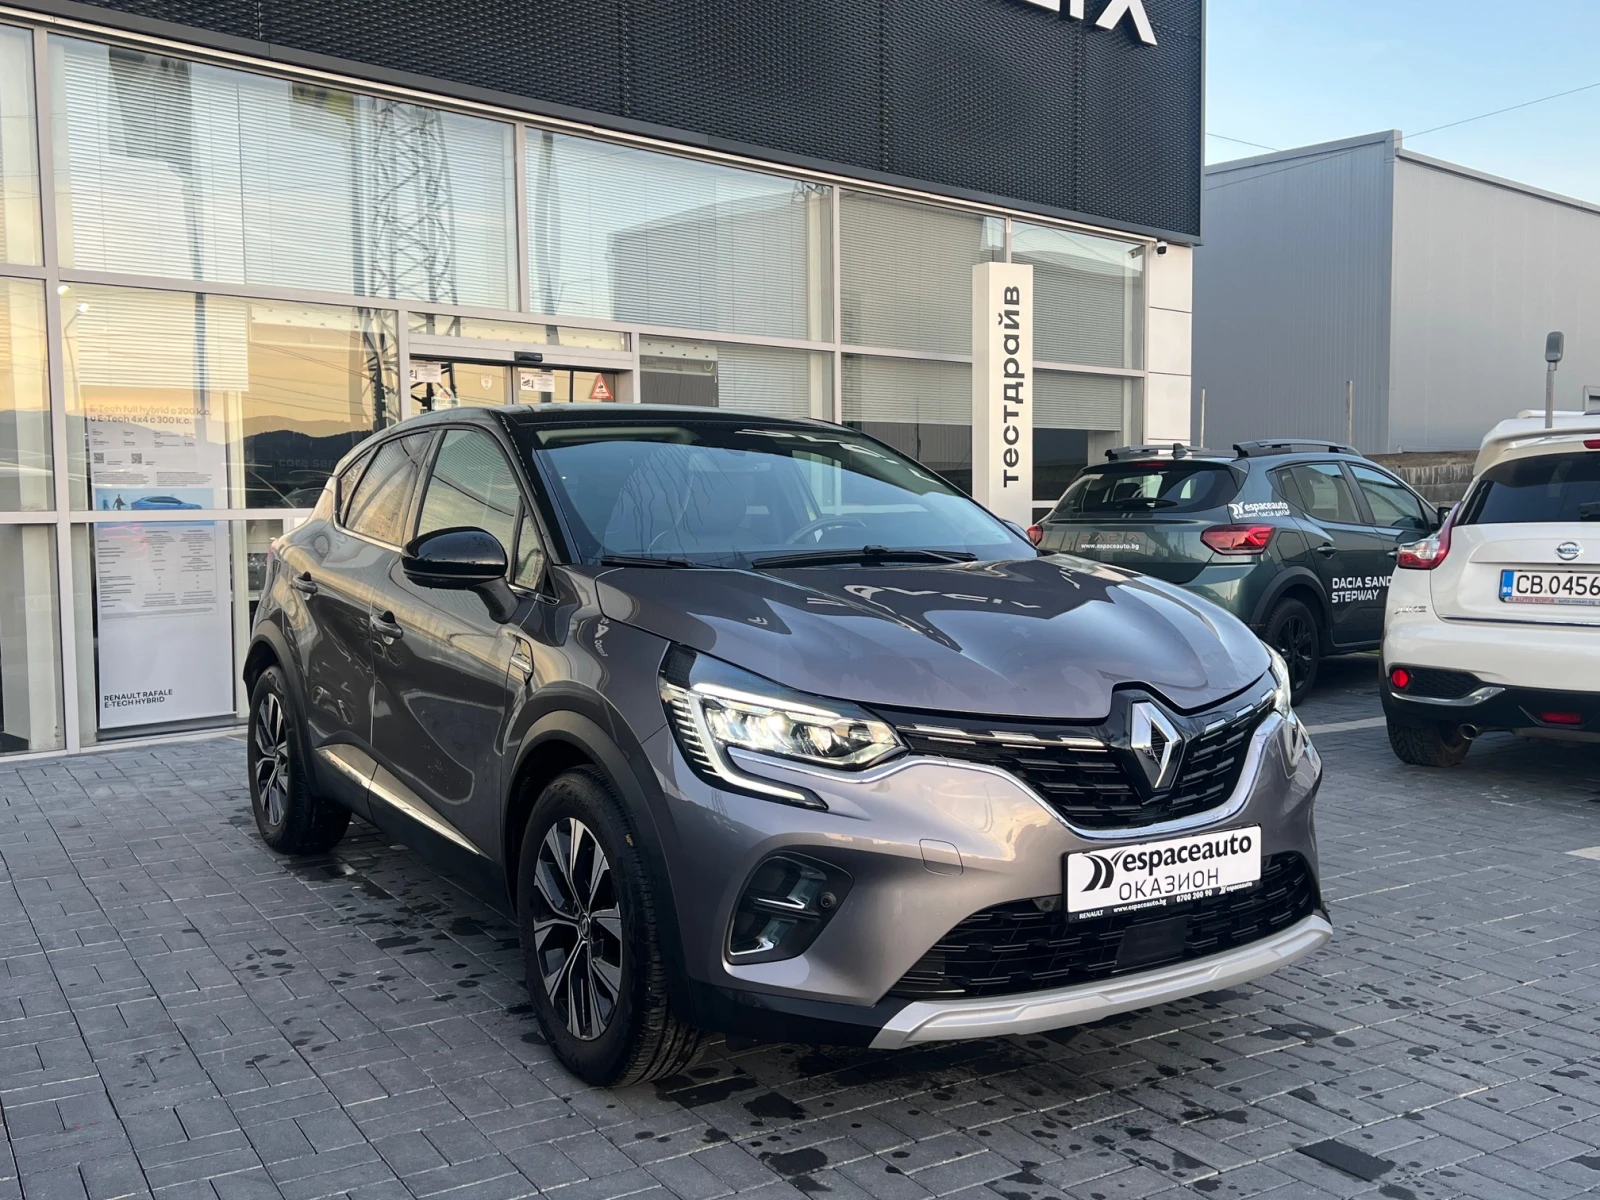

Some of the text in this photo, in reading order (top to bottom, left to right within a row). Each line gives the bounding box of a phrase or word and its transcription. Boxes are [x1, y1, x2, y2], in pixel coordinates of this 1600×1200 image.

[998, 285, 1025, 489] тестдрайв
[123, 405, 138, 413] full
[140, 405, 169, 415] hybrid
[97, 415, 130, 423] E-Tech
[131, 416, 149, 424] 4x4
[157, 416, 175, 424] 300
[1244, 501, 1289, 512] espaceauto
[1082, 533, 1140, 541] DACIA
[1332, 577, 1363, 589] DACIA
[1331, 589, 1379, 603] STEPWAY
[104, 688, 173, 702] RENAULT RAFALE
[104, 696, 165, 708] E-TECH HYBRID
[1122, 833, 1252, 876] espaceauto
[1119, 867, 1219, 901] ОКАЗИОН
[1079, 909, 1104, 919] RENAULT
[1113, 897, 1167, 913] www.espaceauto.bg
[1176, 892, 1192, 903] 0700
